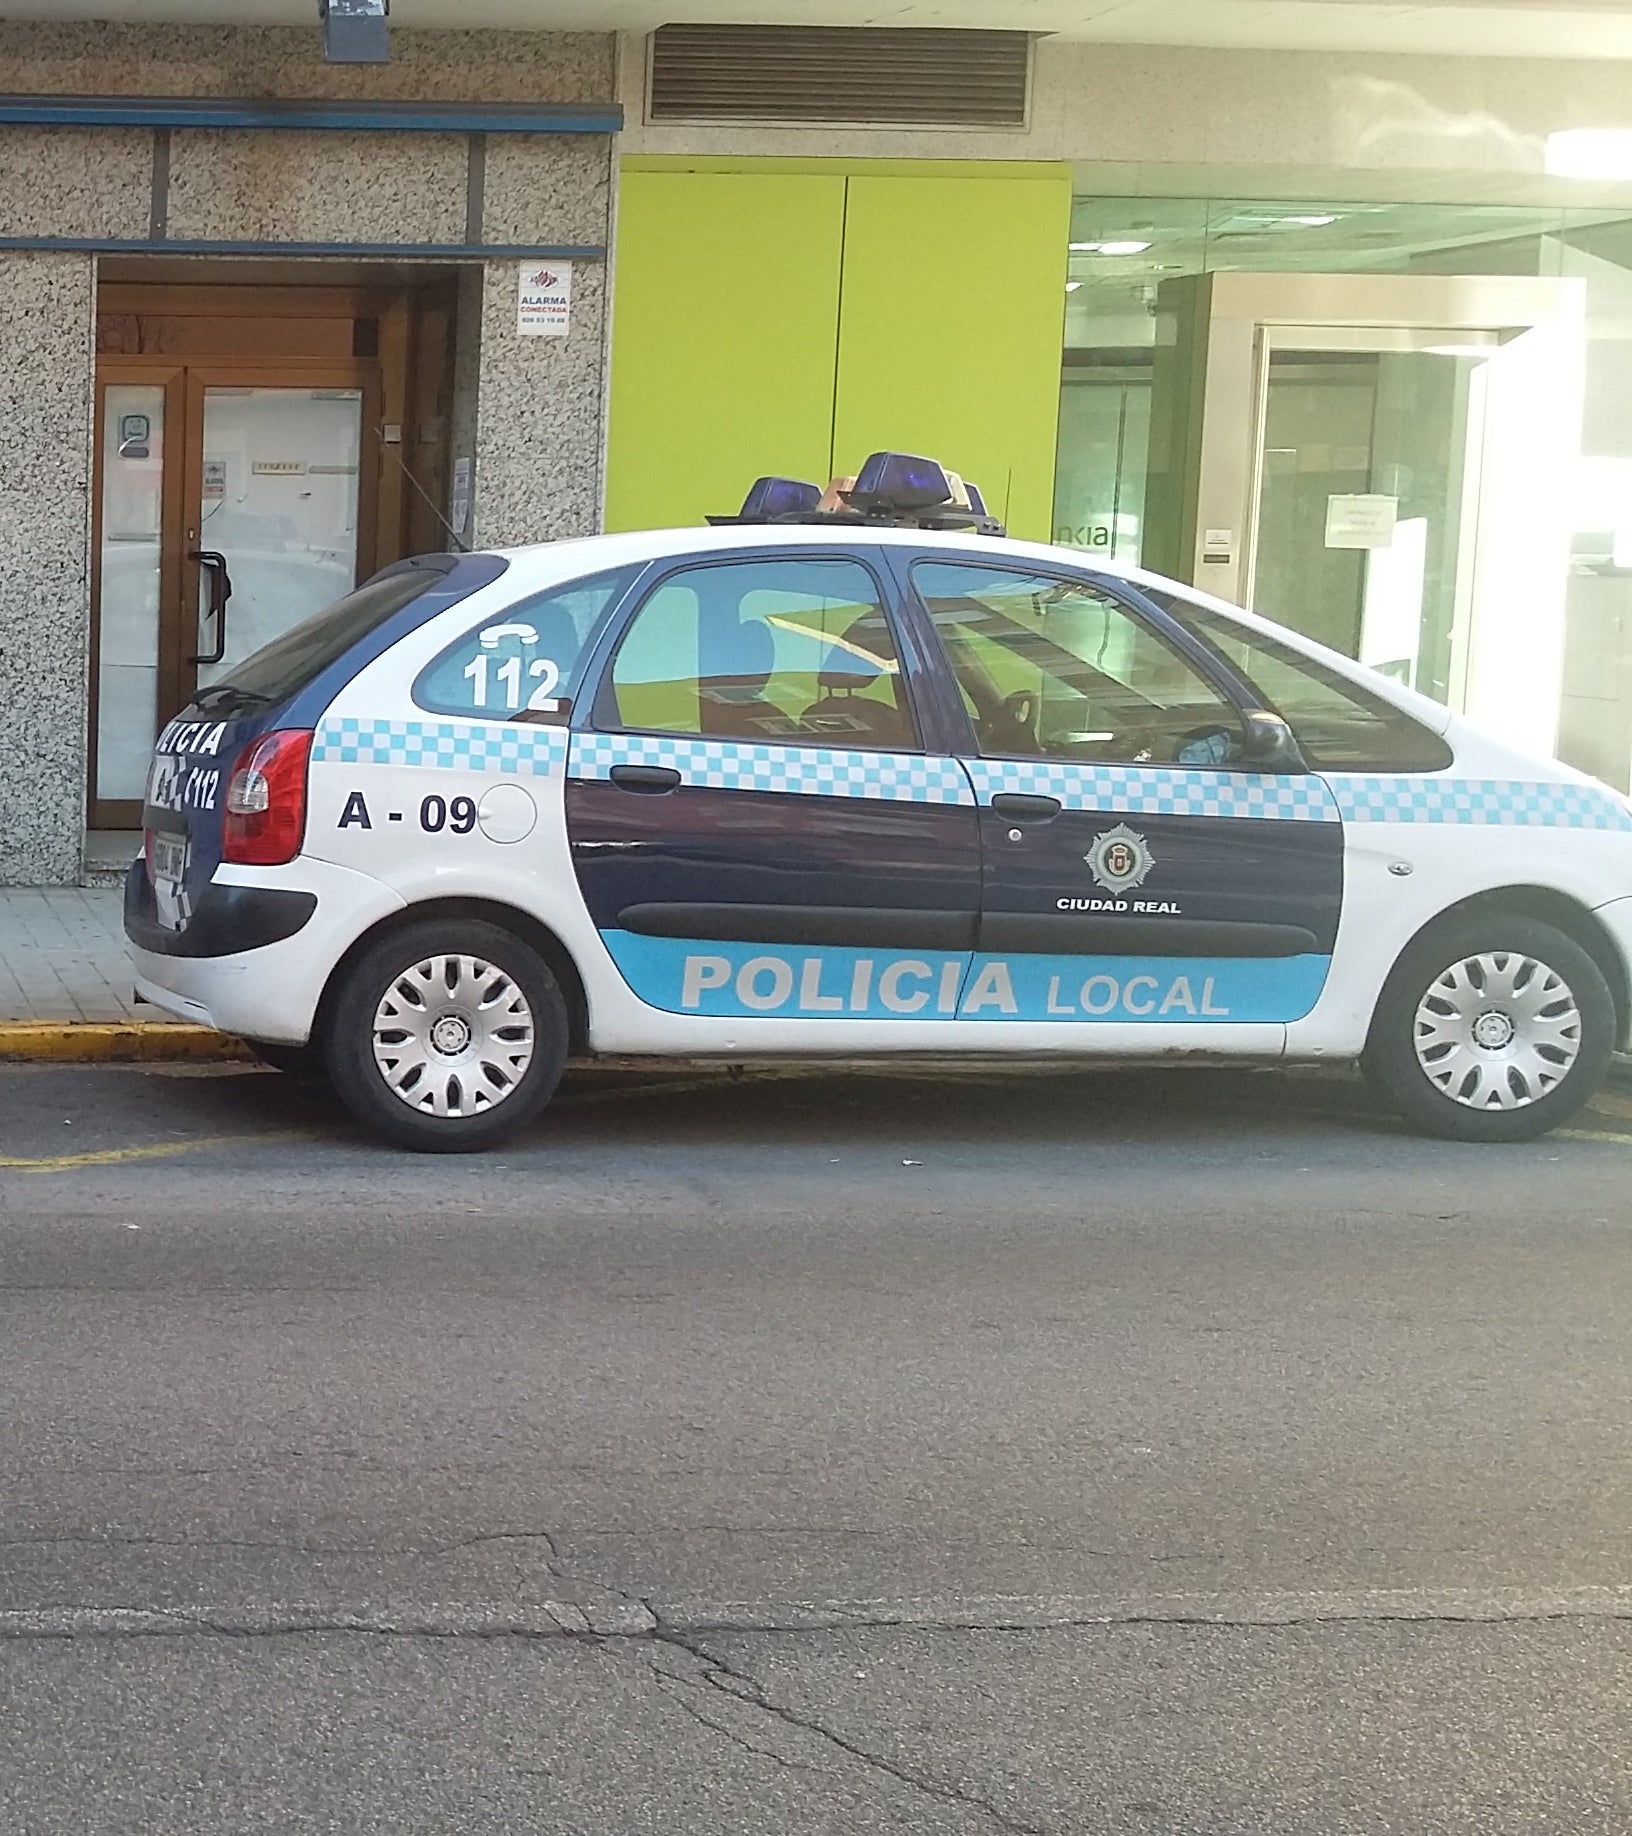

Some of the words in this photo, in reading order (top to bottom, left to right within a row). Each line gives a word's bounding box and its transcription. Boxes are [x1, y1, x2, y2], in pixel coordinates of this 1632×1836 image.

[521, 296, 567, 305] ALARMA
[464, 654, 559, 712] 112
[193, 769, 219, 810] 112
[338, 791, 372, 830] A
[388, 813, 403, 822] -
[419, 795, 477, 834] 09
[1056, 898, 1128, 912] CIUDAD
[1133, 901, 1182, 914] REAL
[680, 955, 1019, 1014] POLICIA
[1046, 975, 1230, 1017] LOCAL
